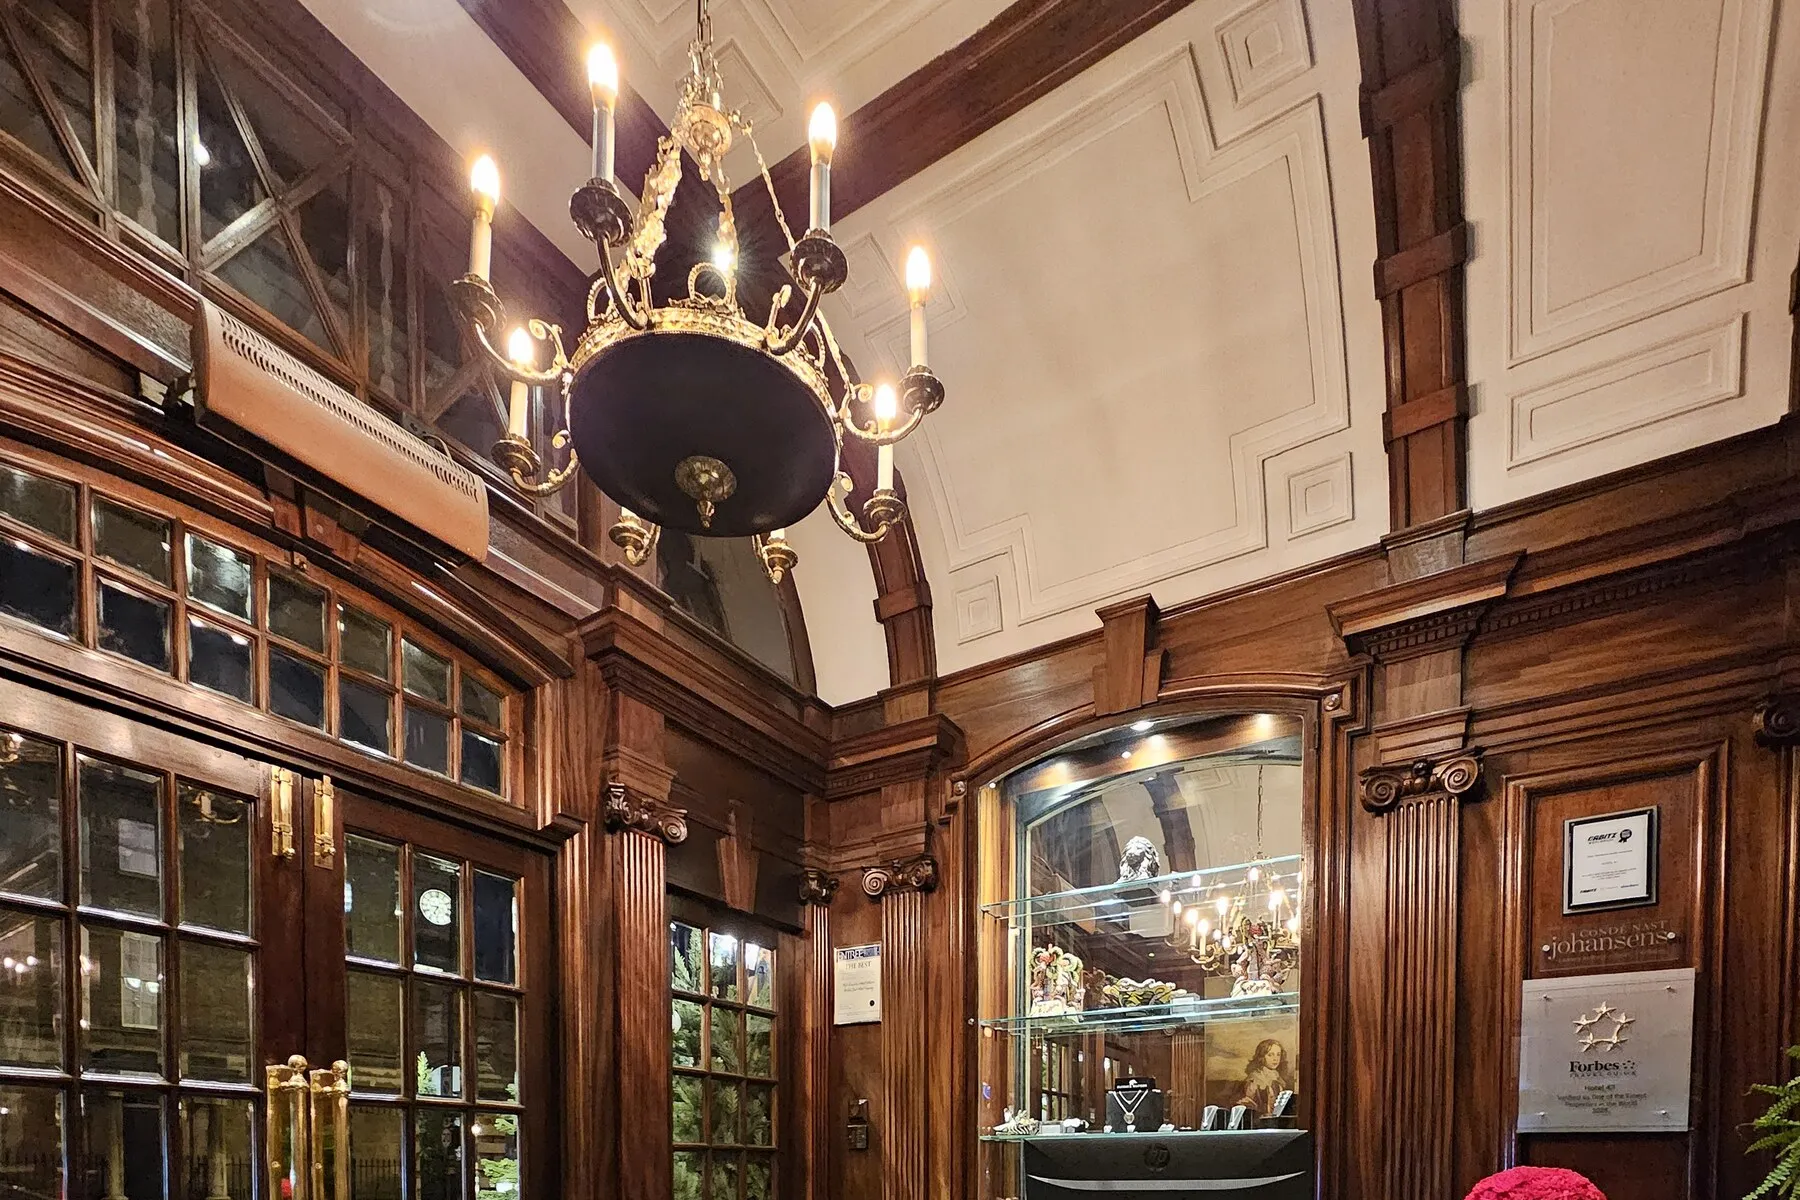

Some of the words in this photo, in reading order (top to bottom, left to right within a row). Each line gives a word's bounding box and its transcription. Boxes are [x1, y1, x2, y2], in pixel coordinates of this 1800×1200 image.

[1588, 832, 1618, 841] ORBITZ
[1632, 920, 1668, 931] NAST
[1547, 930, 1668, 960] johansens
[1569, 1060, 1620, 1072] Forbes
